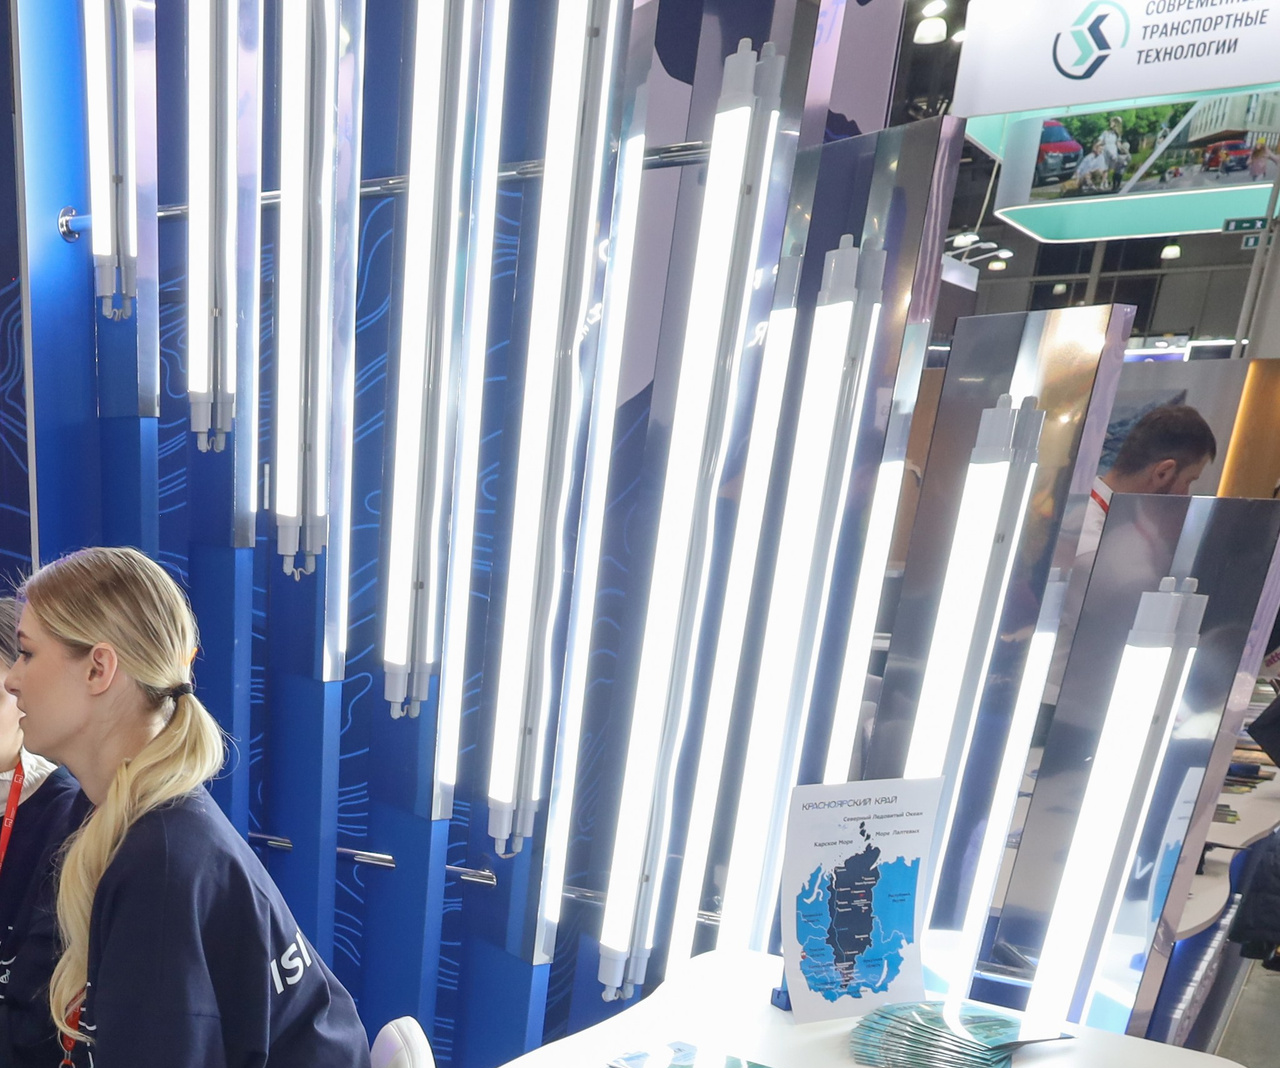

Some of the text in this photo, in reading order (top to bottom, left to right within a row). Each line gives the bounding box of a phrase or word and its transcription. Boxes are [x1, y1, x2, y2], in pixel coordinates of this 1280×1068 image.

[1142, 9, 1269, 40] ТРАНСПОРТНЫЕ
[1137, 38, 1238, 65] ТЕХНОЛОГИИ
[802, 796, 897, 810] КРАСНОЯРСКИЙ КРАЙ
